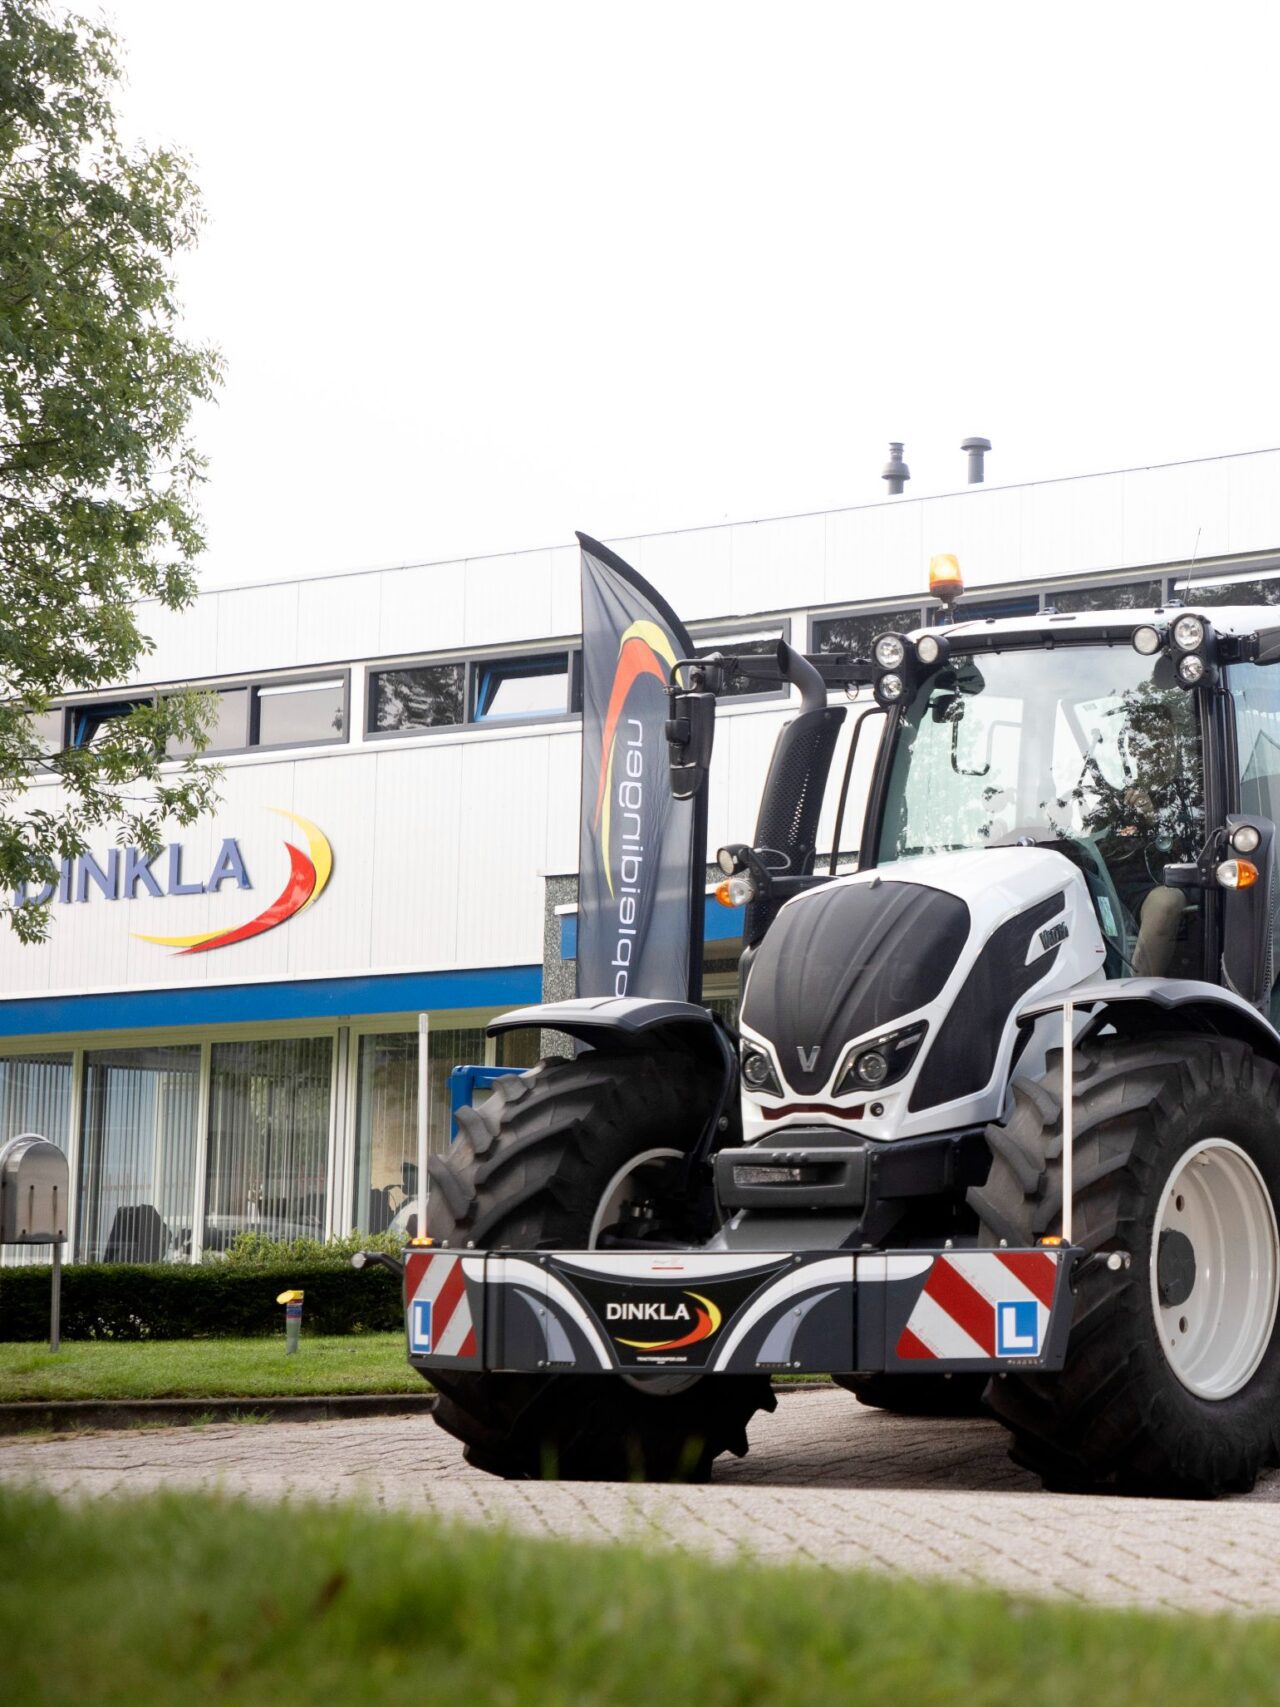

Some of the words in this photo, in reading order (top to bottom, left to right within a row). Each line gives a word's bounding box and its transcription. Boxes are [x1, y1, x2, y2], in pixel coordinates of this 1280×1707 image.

[413, 1305, 430, 1346] L
[606, 1303, 691, 1320] DINKLA
[1002, 1307, 1034, 1348] L
